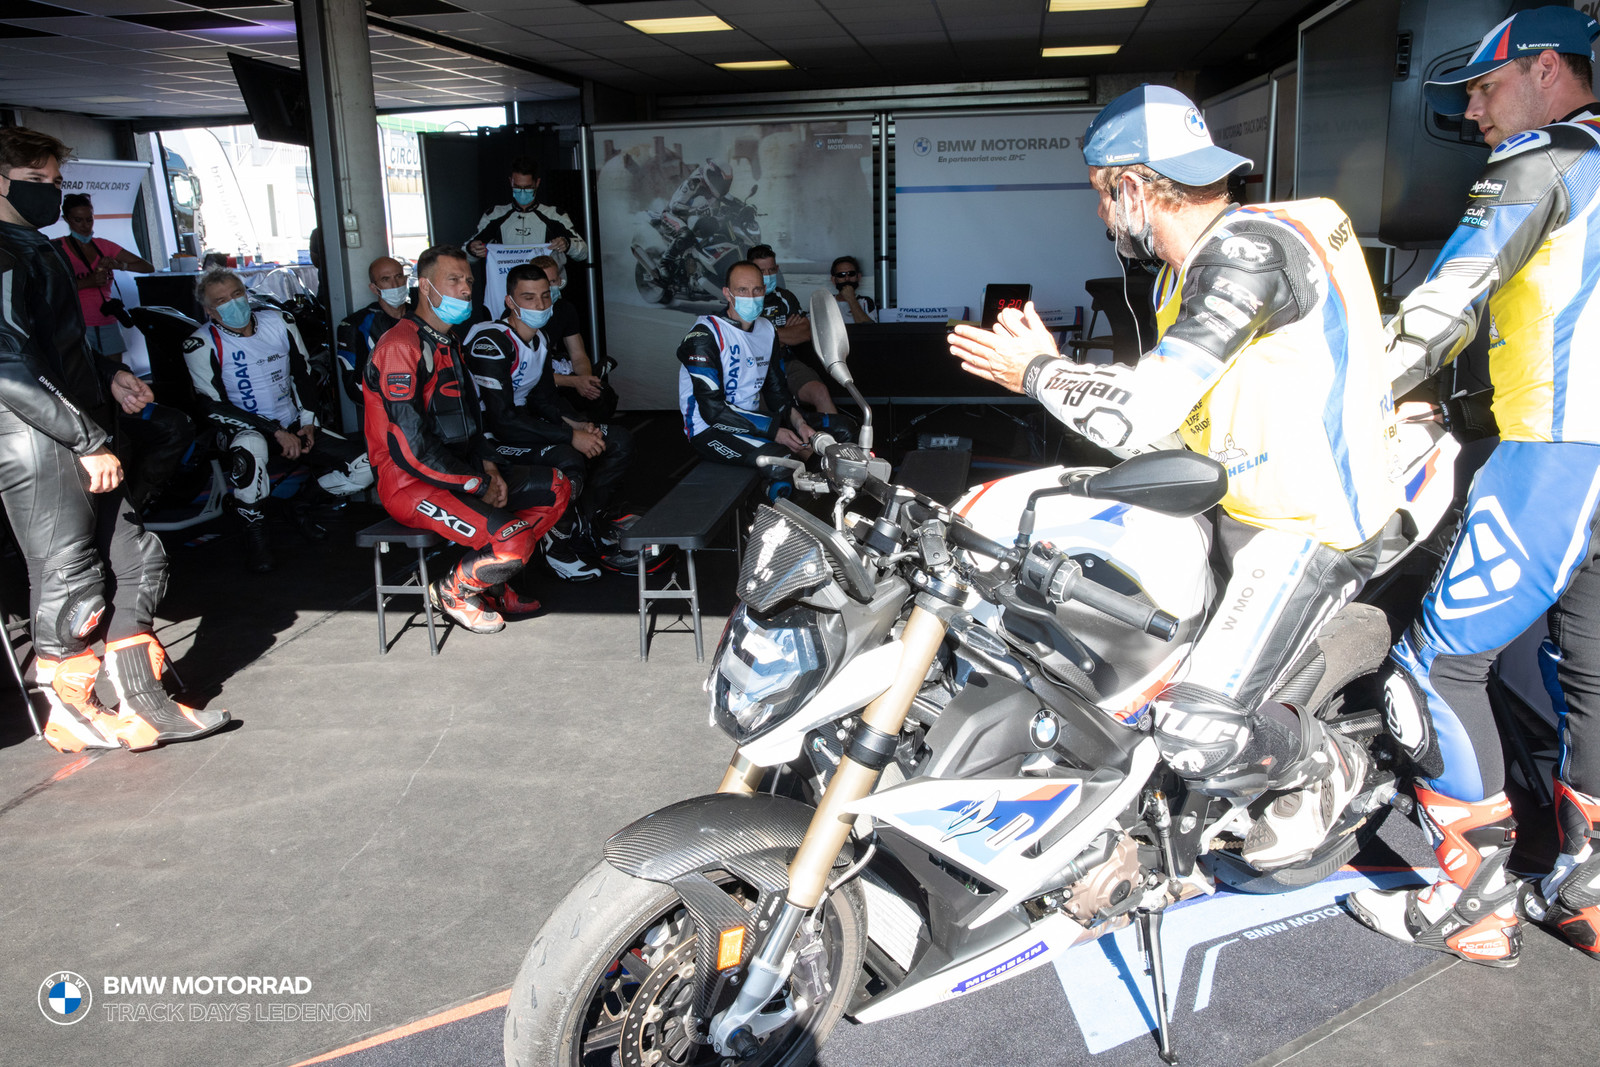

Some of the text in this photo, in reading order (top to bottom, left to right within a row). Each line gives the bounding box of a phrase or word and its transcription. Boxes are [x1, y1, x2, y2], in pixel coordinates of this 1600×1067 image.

[937, 140, 976, 152] BMW
[981, 137, 1070, 151] MOTORRAD
[948, 155, 989, 164] partenariat
[86, 181, 111, 190] TRACK
[111, 182, 131, 191] DAYS
[38, 375, 57, 392] BMW
[495, 445, 532, 457] RST
[707, 439, 742, 460] RST
[1242, 922, 1290, 940] BMW
[965, 944, 1042, 989] MICHELIN
